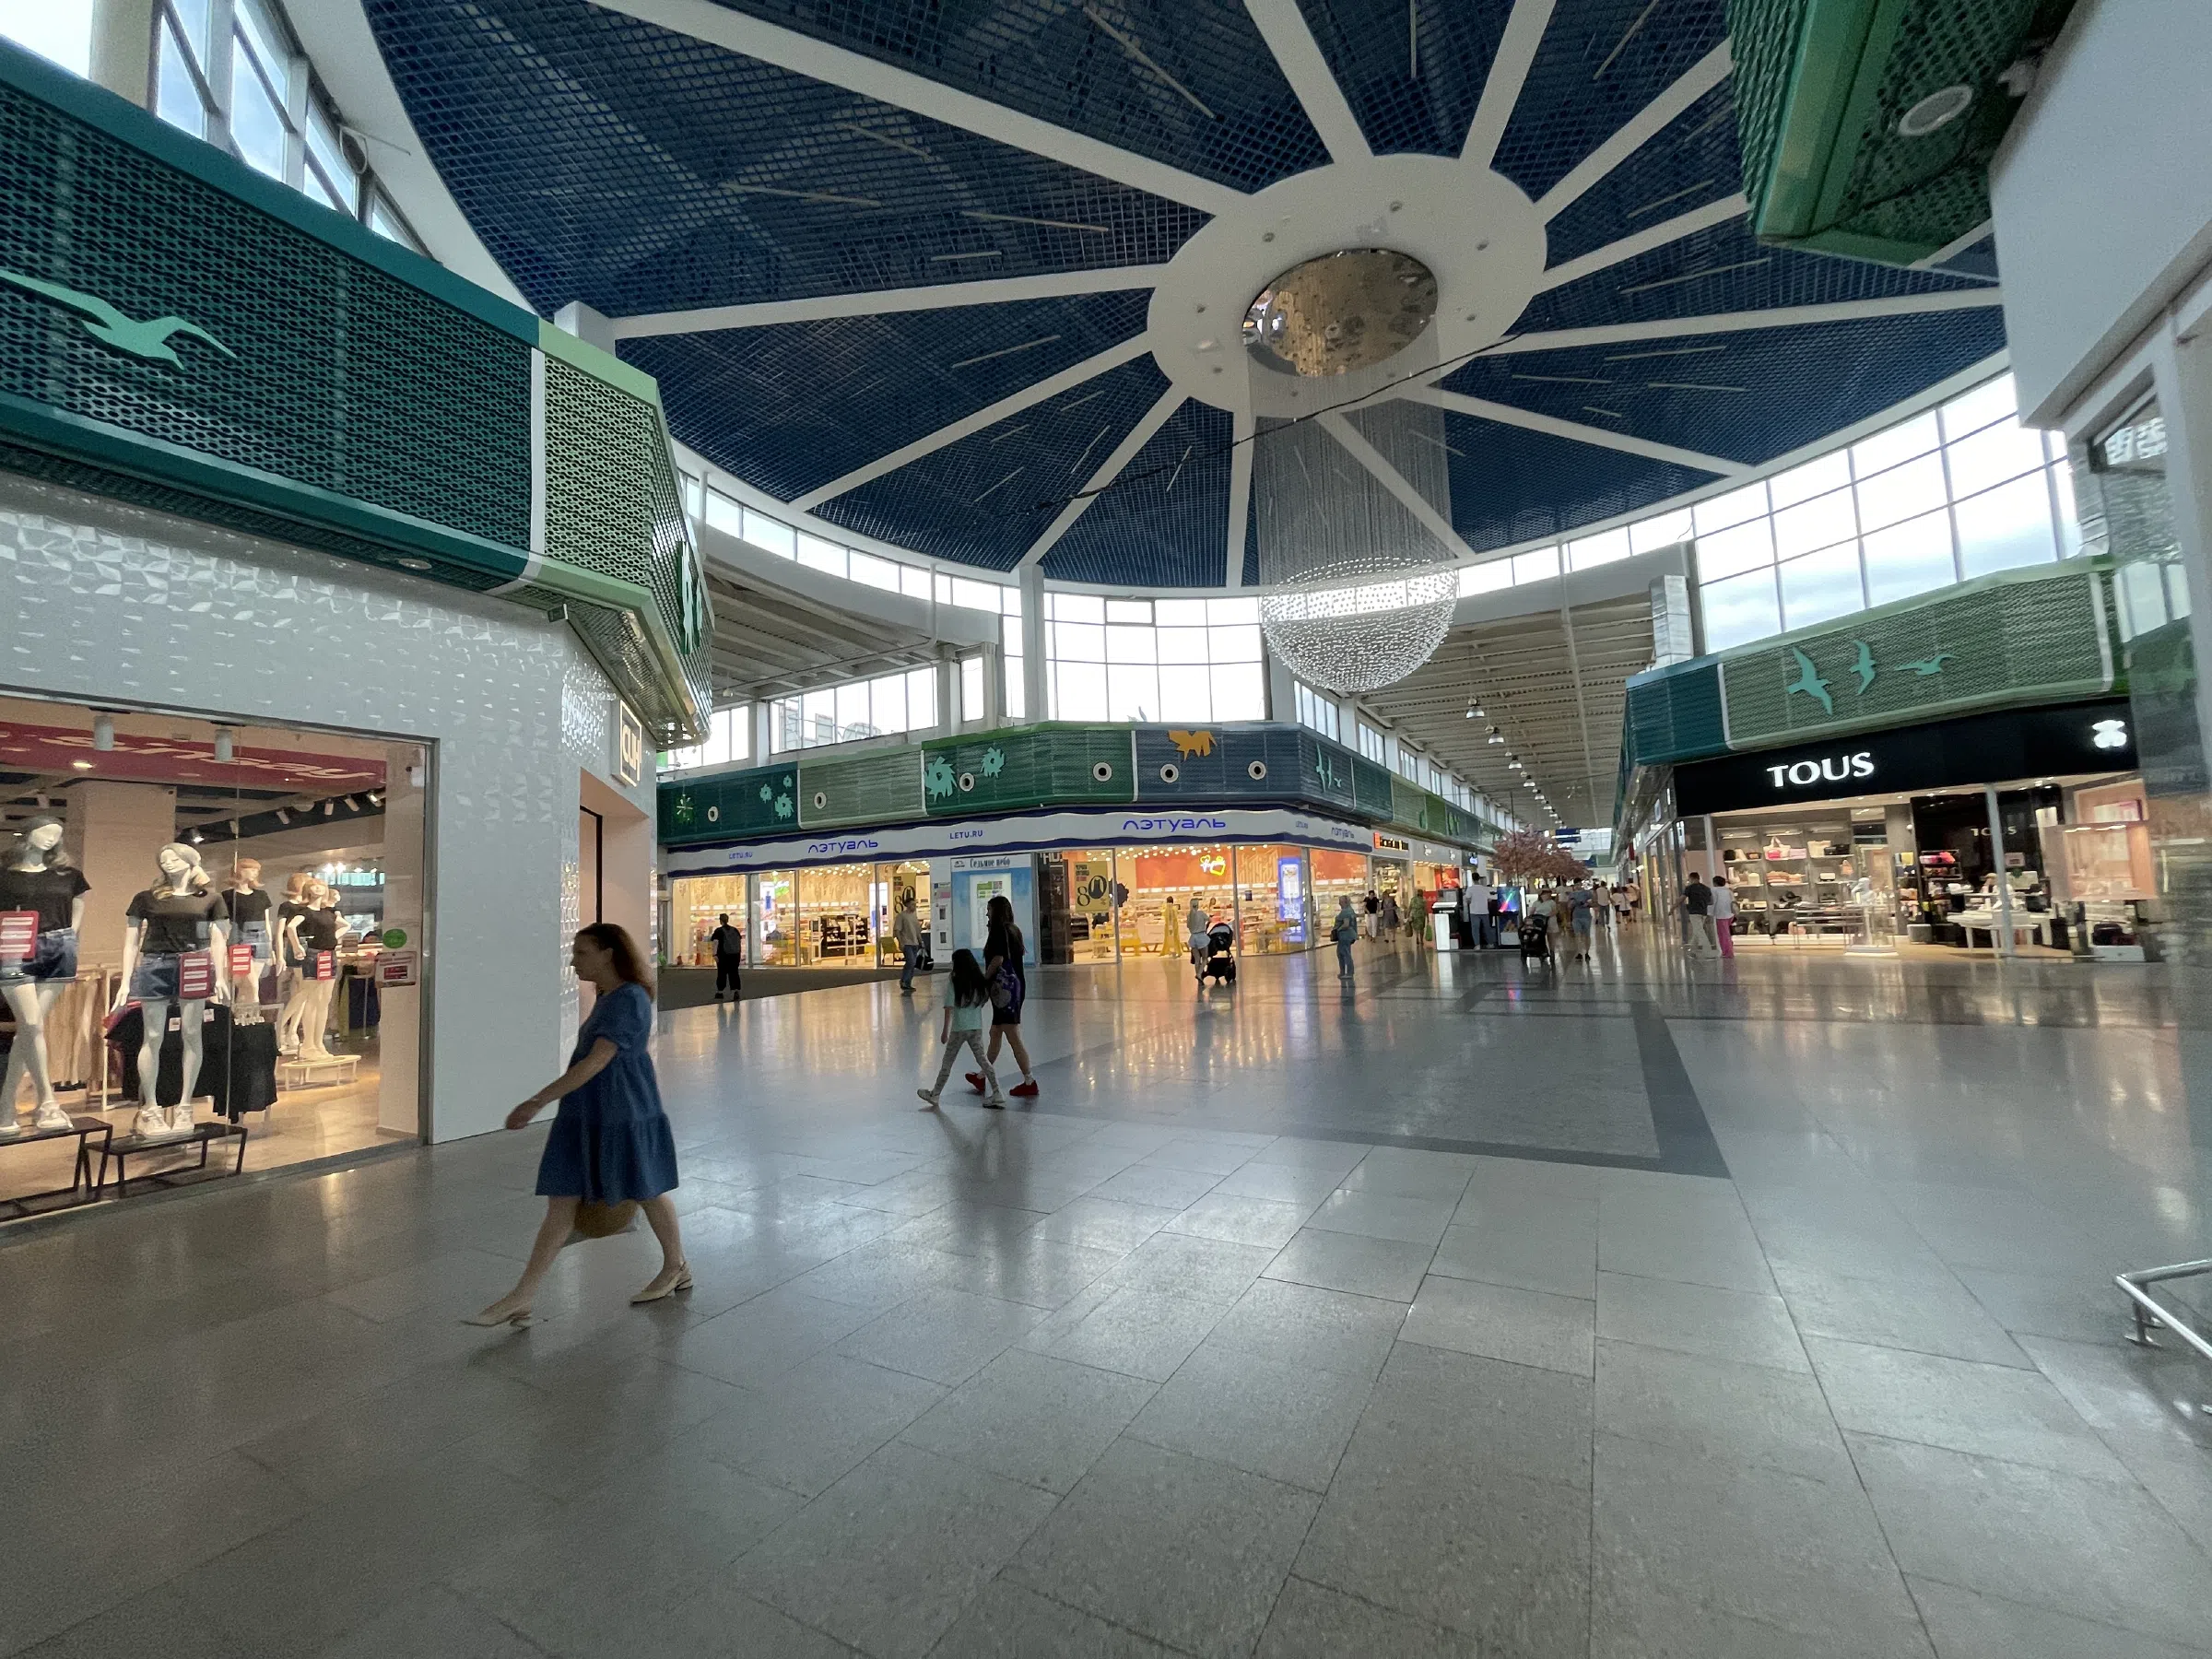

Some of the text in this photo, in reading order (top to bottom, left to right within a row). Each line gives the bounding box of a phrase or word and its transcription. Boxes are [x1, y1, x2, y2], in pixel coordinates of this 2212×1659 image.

[1766, 752, 1875, 787] TOUS
[949, 830, 983, 840] LETU.RU
[1971, 826, 2017, 837] TOS
